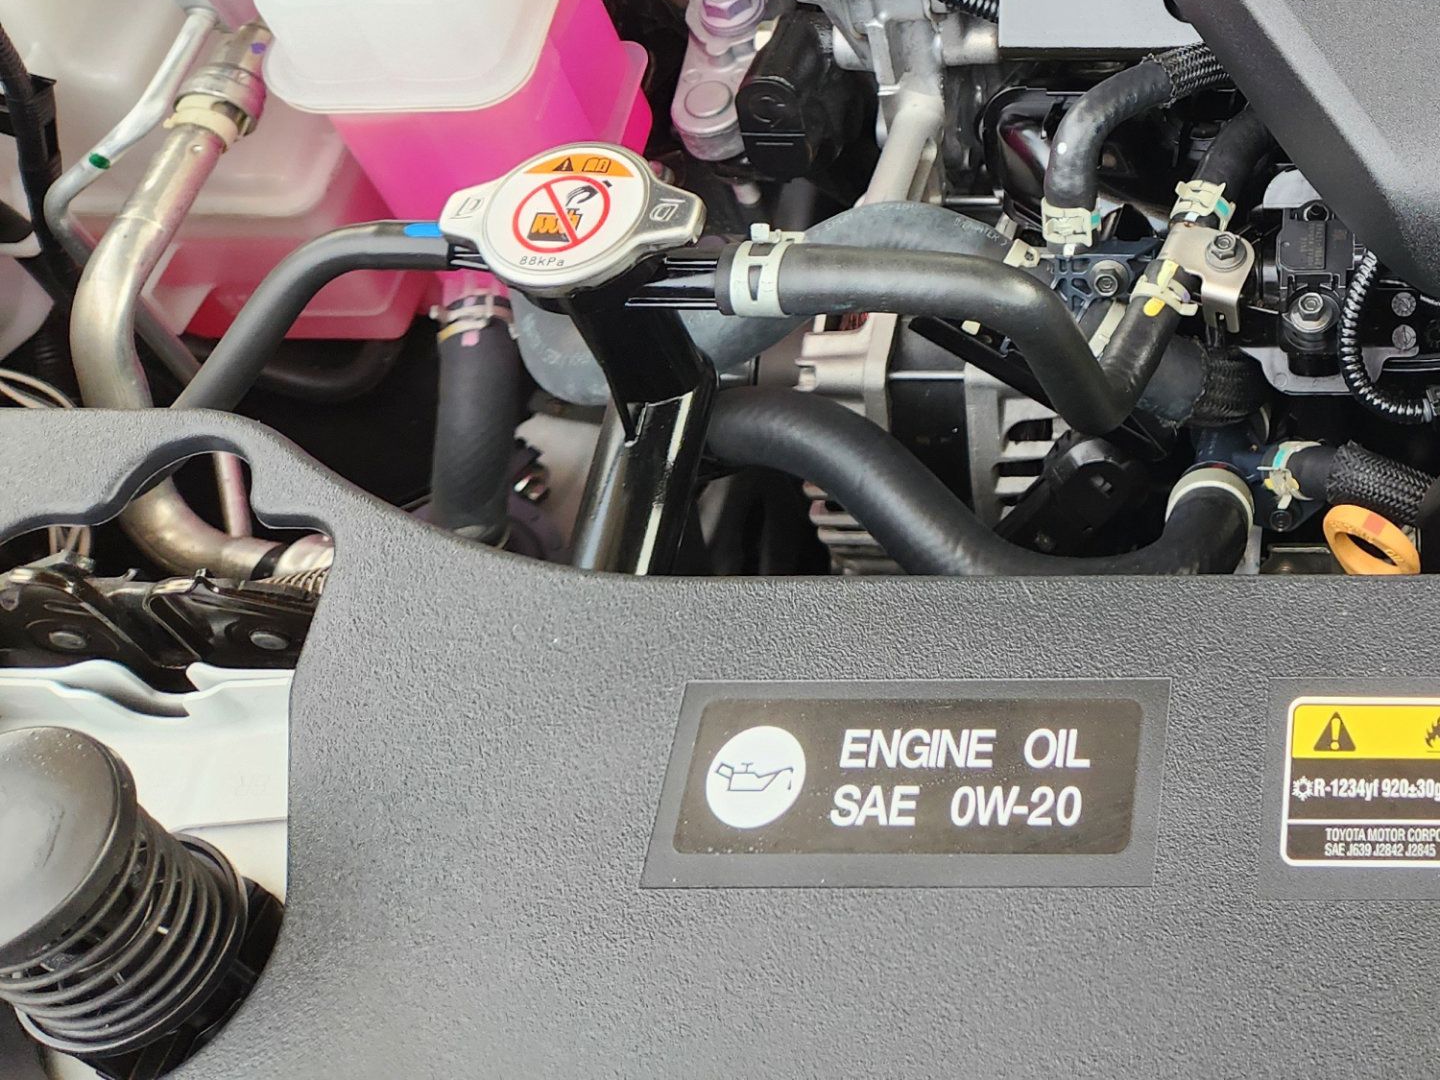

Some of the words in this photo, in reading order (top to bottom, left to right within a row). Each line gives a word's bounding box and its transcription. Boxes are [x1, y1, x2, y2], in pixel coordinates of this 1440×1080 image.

[518, 254, 565, 268] 88kPa
[839, 728, 997, 769] ENGINE
[1023, 727, 1091, 769] OIL
[1313, 777, 1380, 802] R-1234yf
[829, 783, 921, 827] SAE
[950, 784, 1083, 827] 0W-20
[1324, 827, 1367, 841] TOYOTA
[1367, 827, 1406, 841] MOTOR
[1324, 842, 1346, 856] SAE
[1346, 842, 1372, 856] J639
[1373, 842, 1404, 857] J2842
[1405, 842, 1437, 857] J2845
